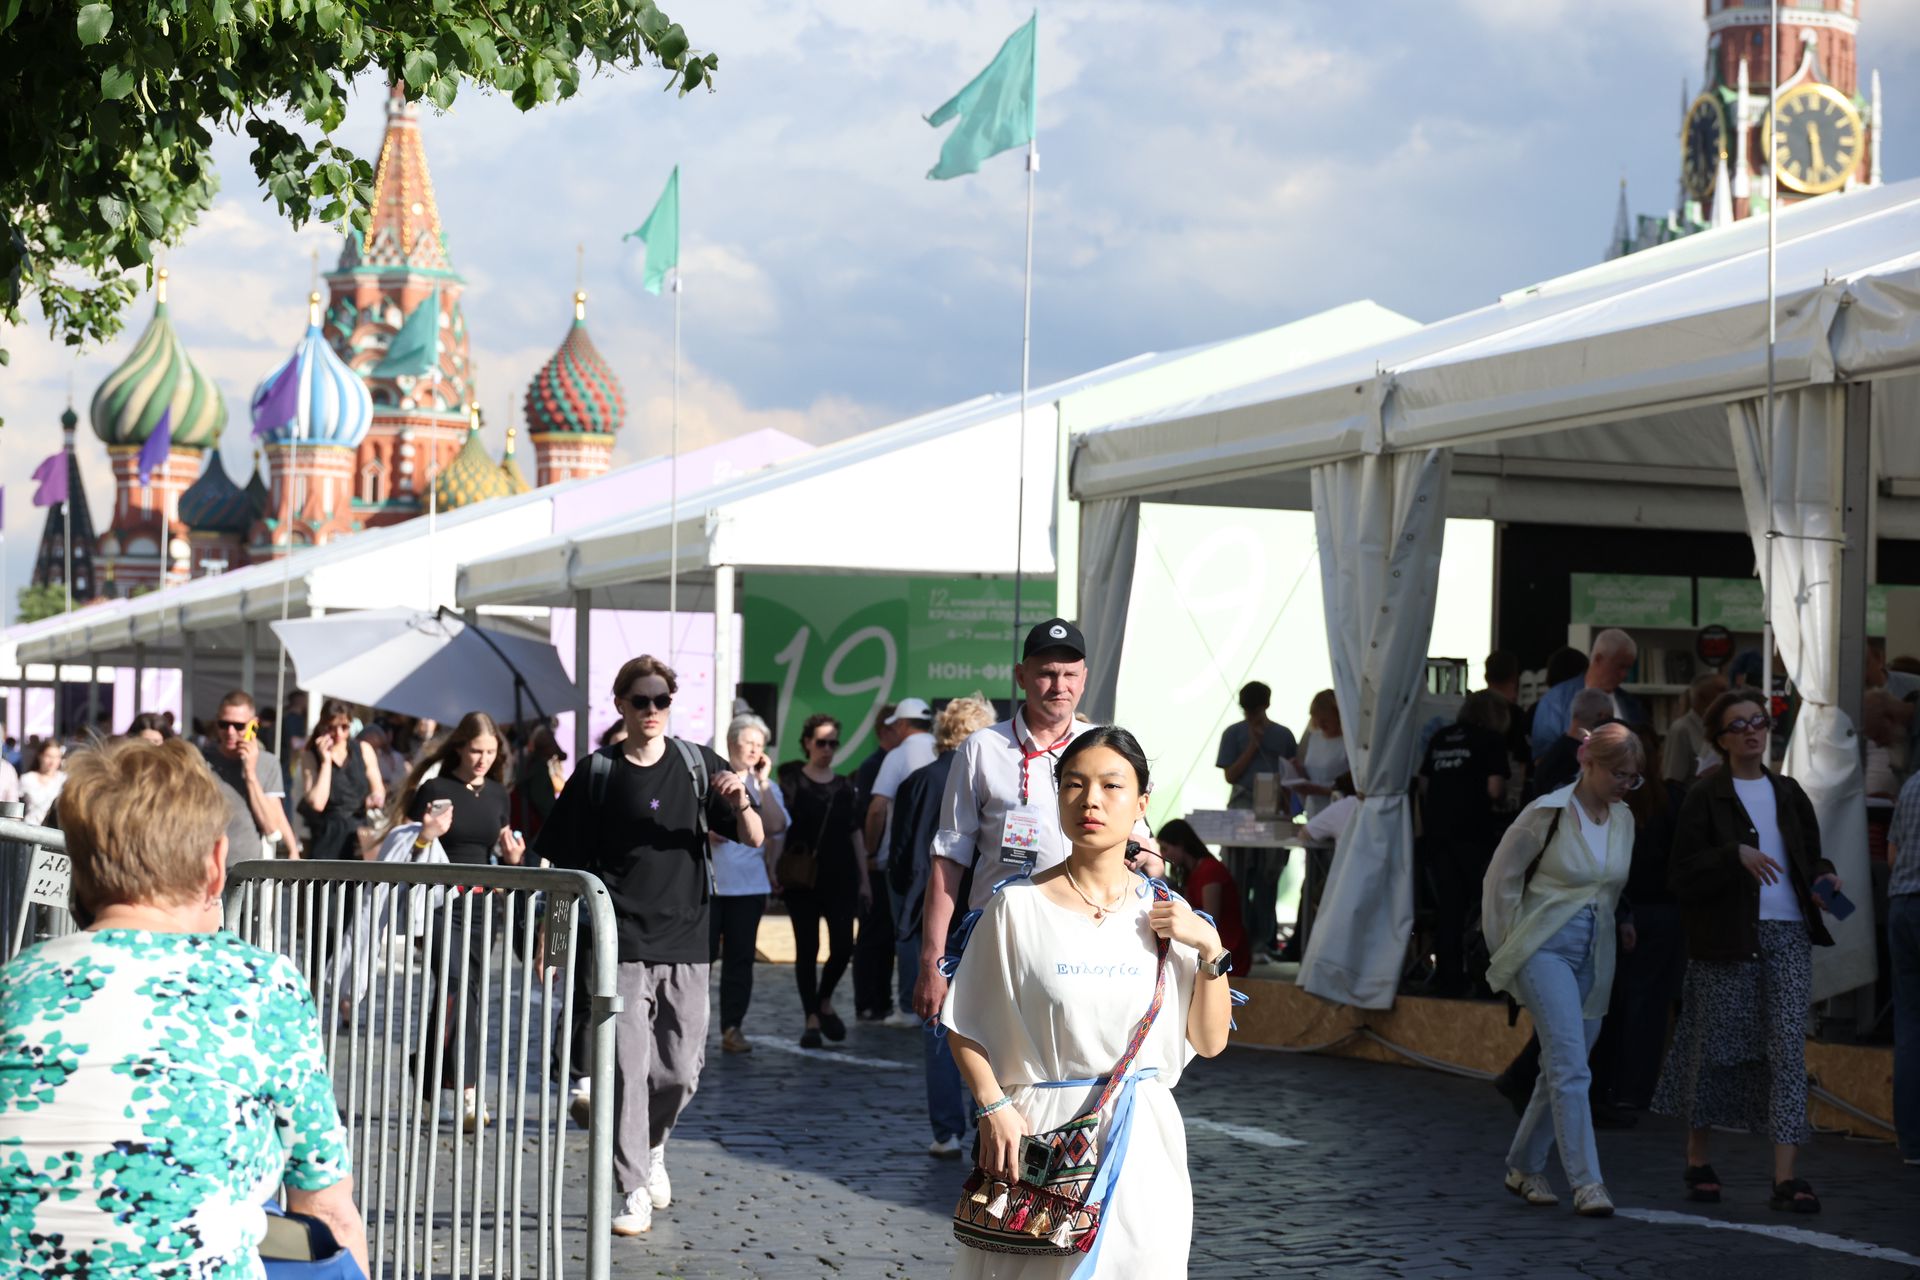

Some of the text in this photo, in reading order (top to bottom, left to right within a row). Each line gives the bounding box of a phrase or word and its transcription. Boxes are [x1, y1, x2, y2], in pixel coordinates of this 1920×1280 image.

[928, 663, 1012, 680] НОН-ФИ
[770, 625, 897, 767] 19
[34, 879, 70, 898] ЦА
[1056, 962, 1139, 978] Ευλογία
